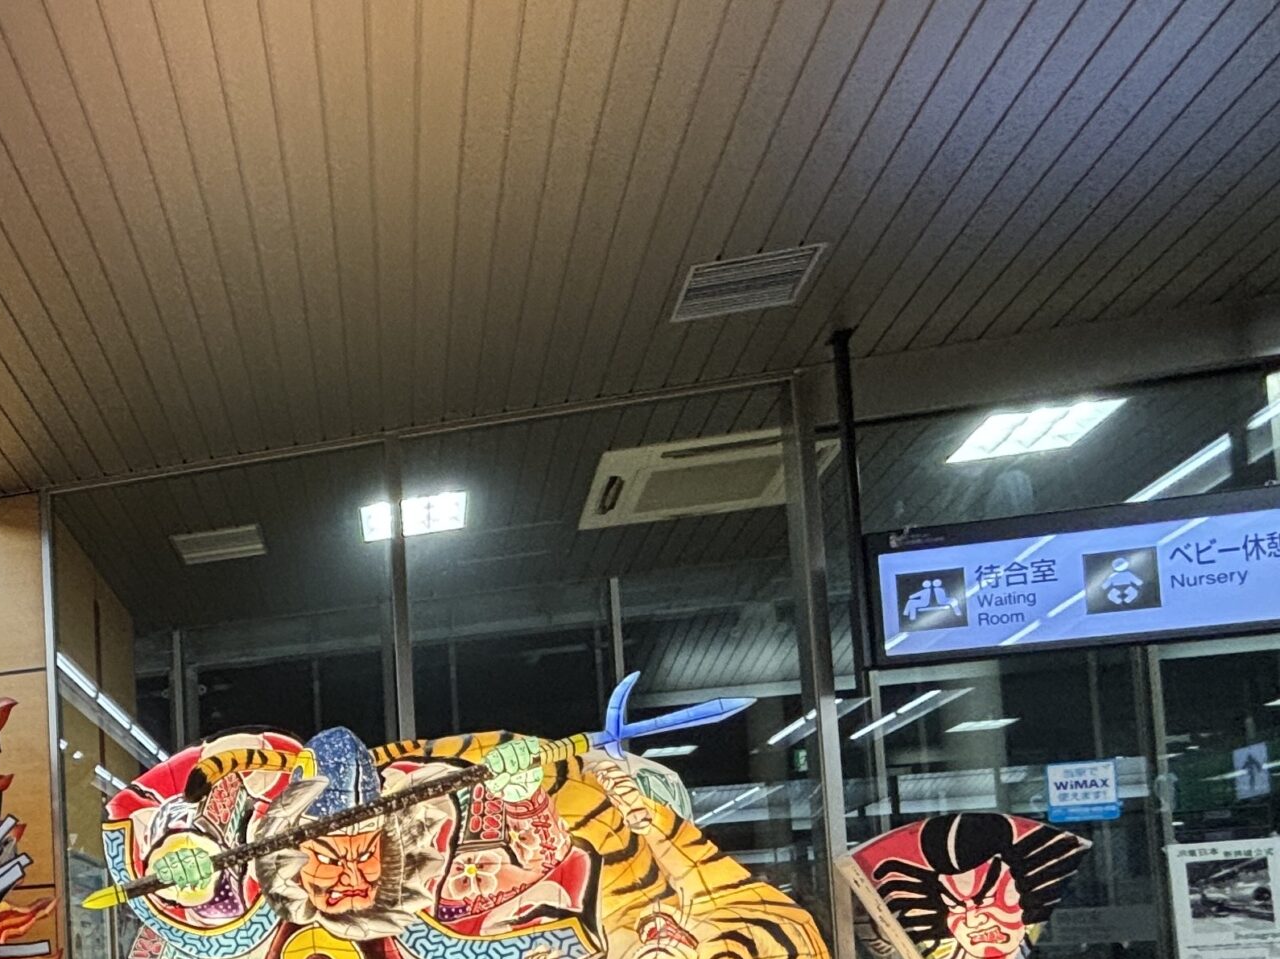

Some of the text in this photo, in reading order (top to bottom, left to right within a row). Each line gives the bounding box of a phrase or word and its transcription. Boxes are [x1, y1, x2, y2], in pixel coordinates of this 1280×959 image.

[974, 559, 1058, 590] 待合室
[1170, 570, 1248, 588] Nursery
[977, 592, 1037, 608] Waiting
[978, 612, 1025, 627] Room
[1054, 778, 1110, 791] WiMAX
